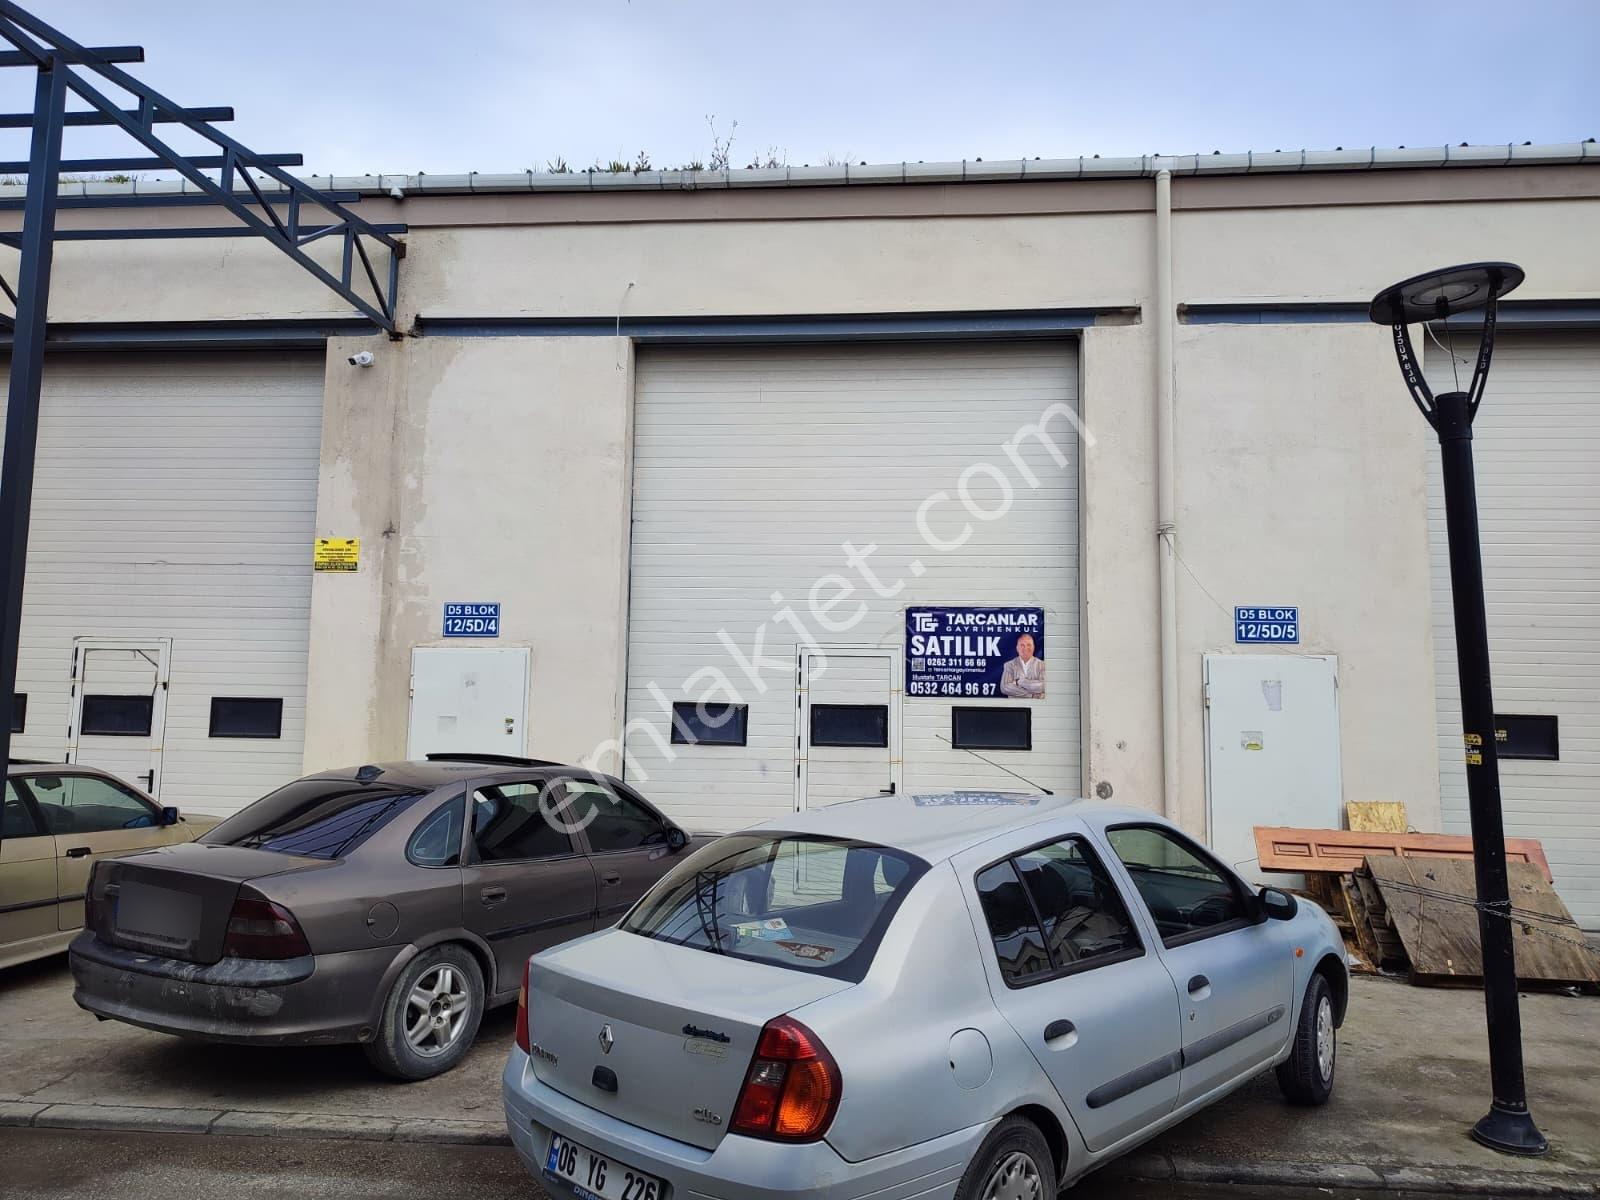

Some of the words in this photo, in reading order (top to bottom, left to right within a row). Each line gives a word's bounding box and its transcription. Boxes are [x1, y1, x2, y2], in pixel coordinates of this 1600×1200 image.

[448, 605, 462, 615] D5
[464, 605, 496, 615] BLOK
[1239, 609, 1255, 619] D5
[1258, 610, 1294, 620] BLOK
[446, 619, 496, 632] 12/5D/4
[946, 613, 1038, 626] TARCANLAR
[1239, 624, 1296, 638] 12/5D/5
[911, 635, 1001, 657] SATILIK
[927, 657, 946, 666] 0262
[948, 657, 962, 666] 311
[964, 658, 975, 667] 66
[976, 658, 987, 667] 66
[910, 682, 938, 694] 0532
[941, 682, 962, 695] 464
[965, 683, 979, 695] 96
[982, 683, 997, 695] 87
[558, 1141, 578, 1177] 06
[587, 1154, 608, 1191] YG
[621, 1172, 657, 1200] 226
